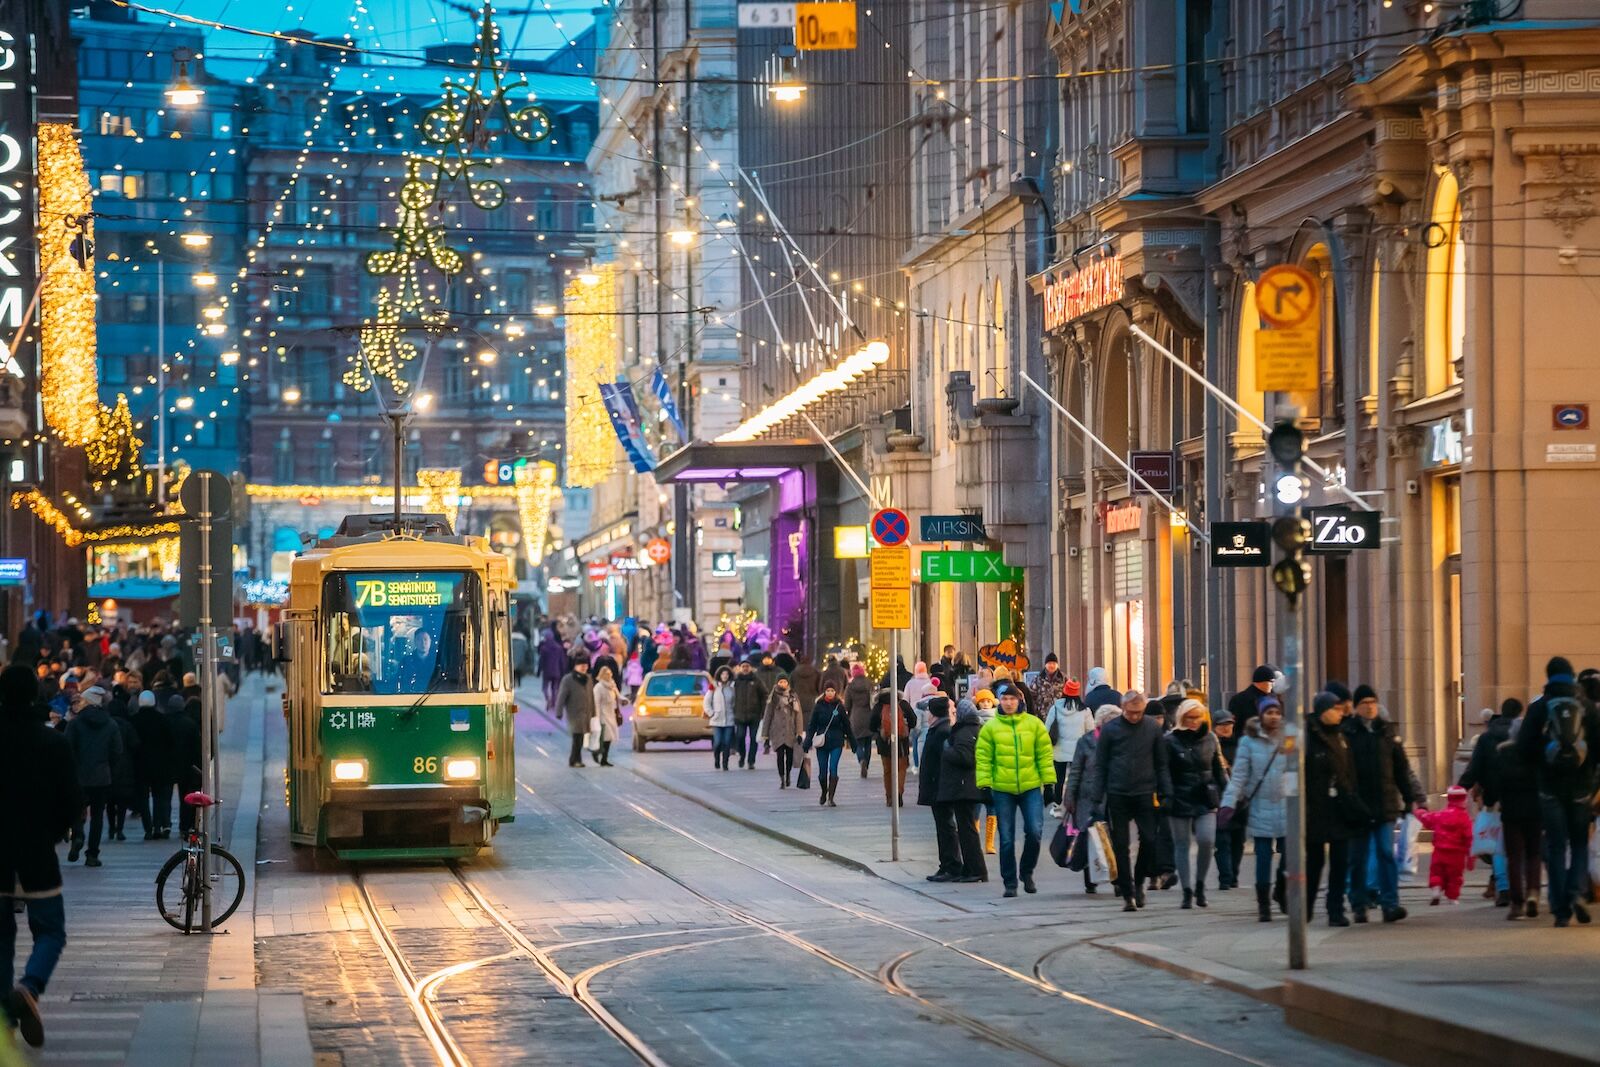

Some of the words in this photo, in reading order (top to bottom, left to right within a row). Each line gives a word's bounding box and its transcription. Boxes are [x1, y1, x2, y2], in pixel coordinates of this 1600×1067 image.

[799, 14, 819, 46] 10
[1136, 468, 1169, 478] CATELLA
[1315, 515, 1366, 544] Zio
[355, 580, 387, 609] 7B
[357, 712, 376, 721] HSL
[357, 720, 376, 729] HRT
[413, 756, 438, 774] 86
